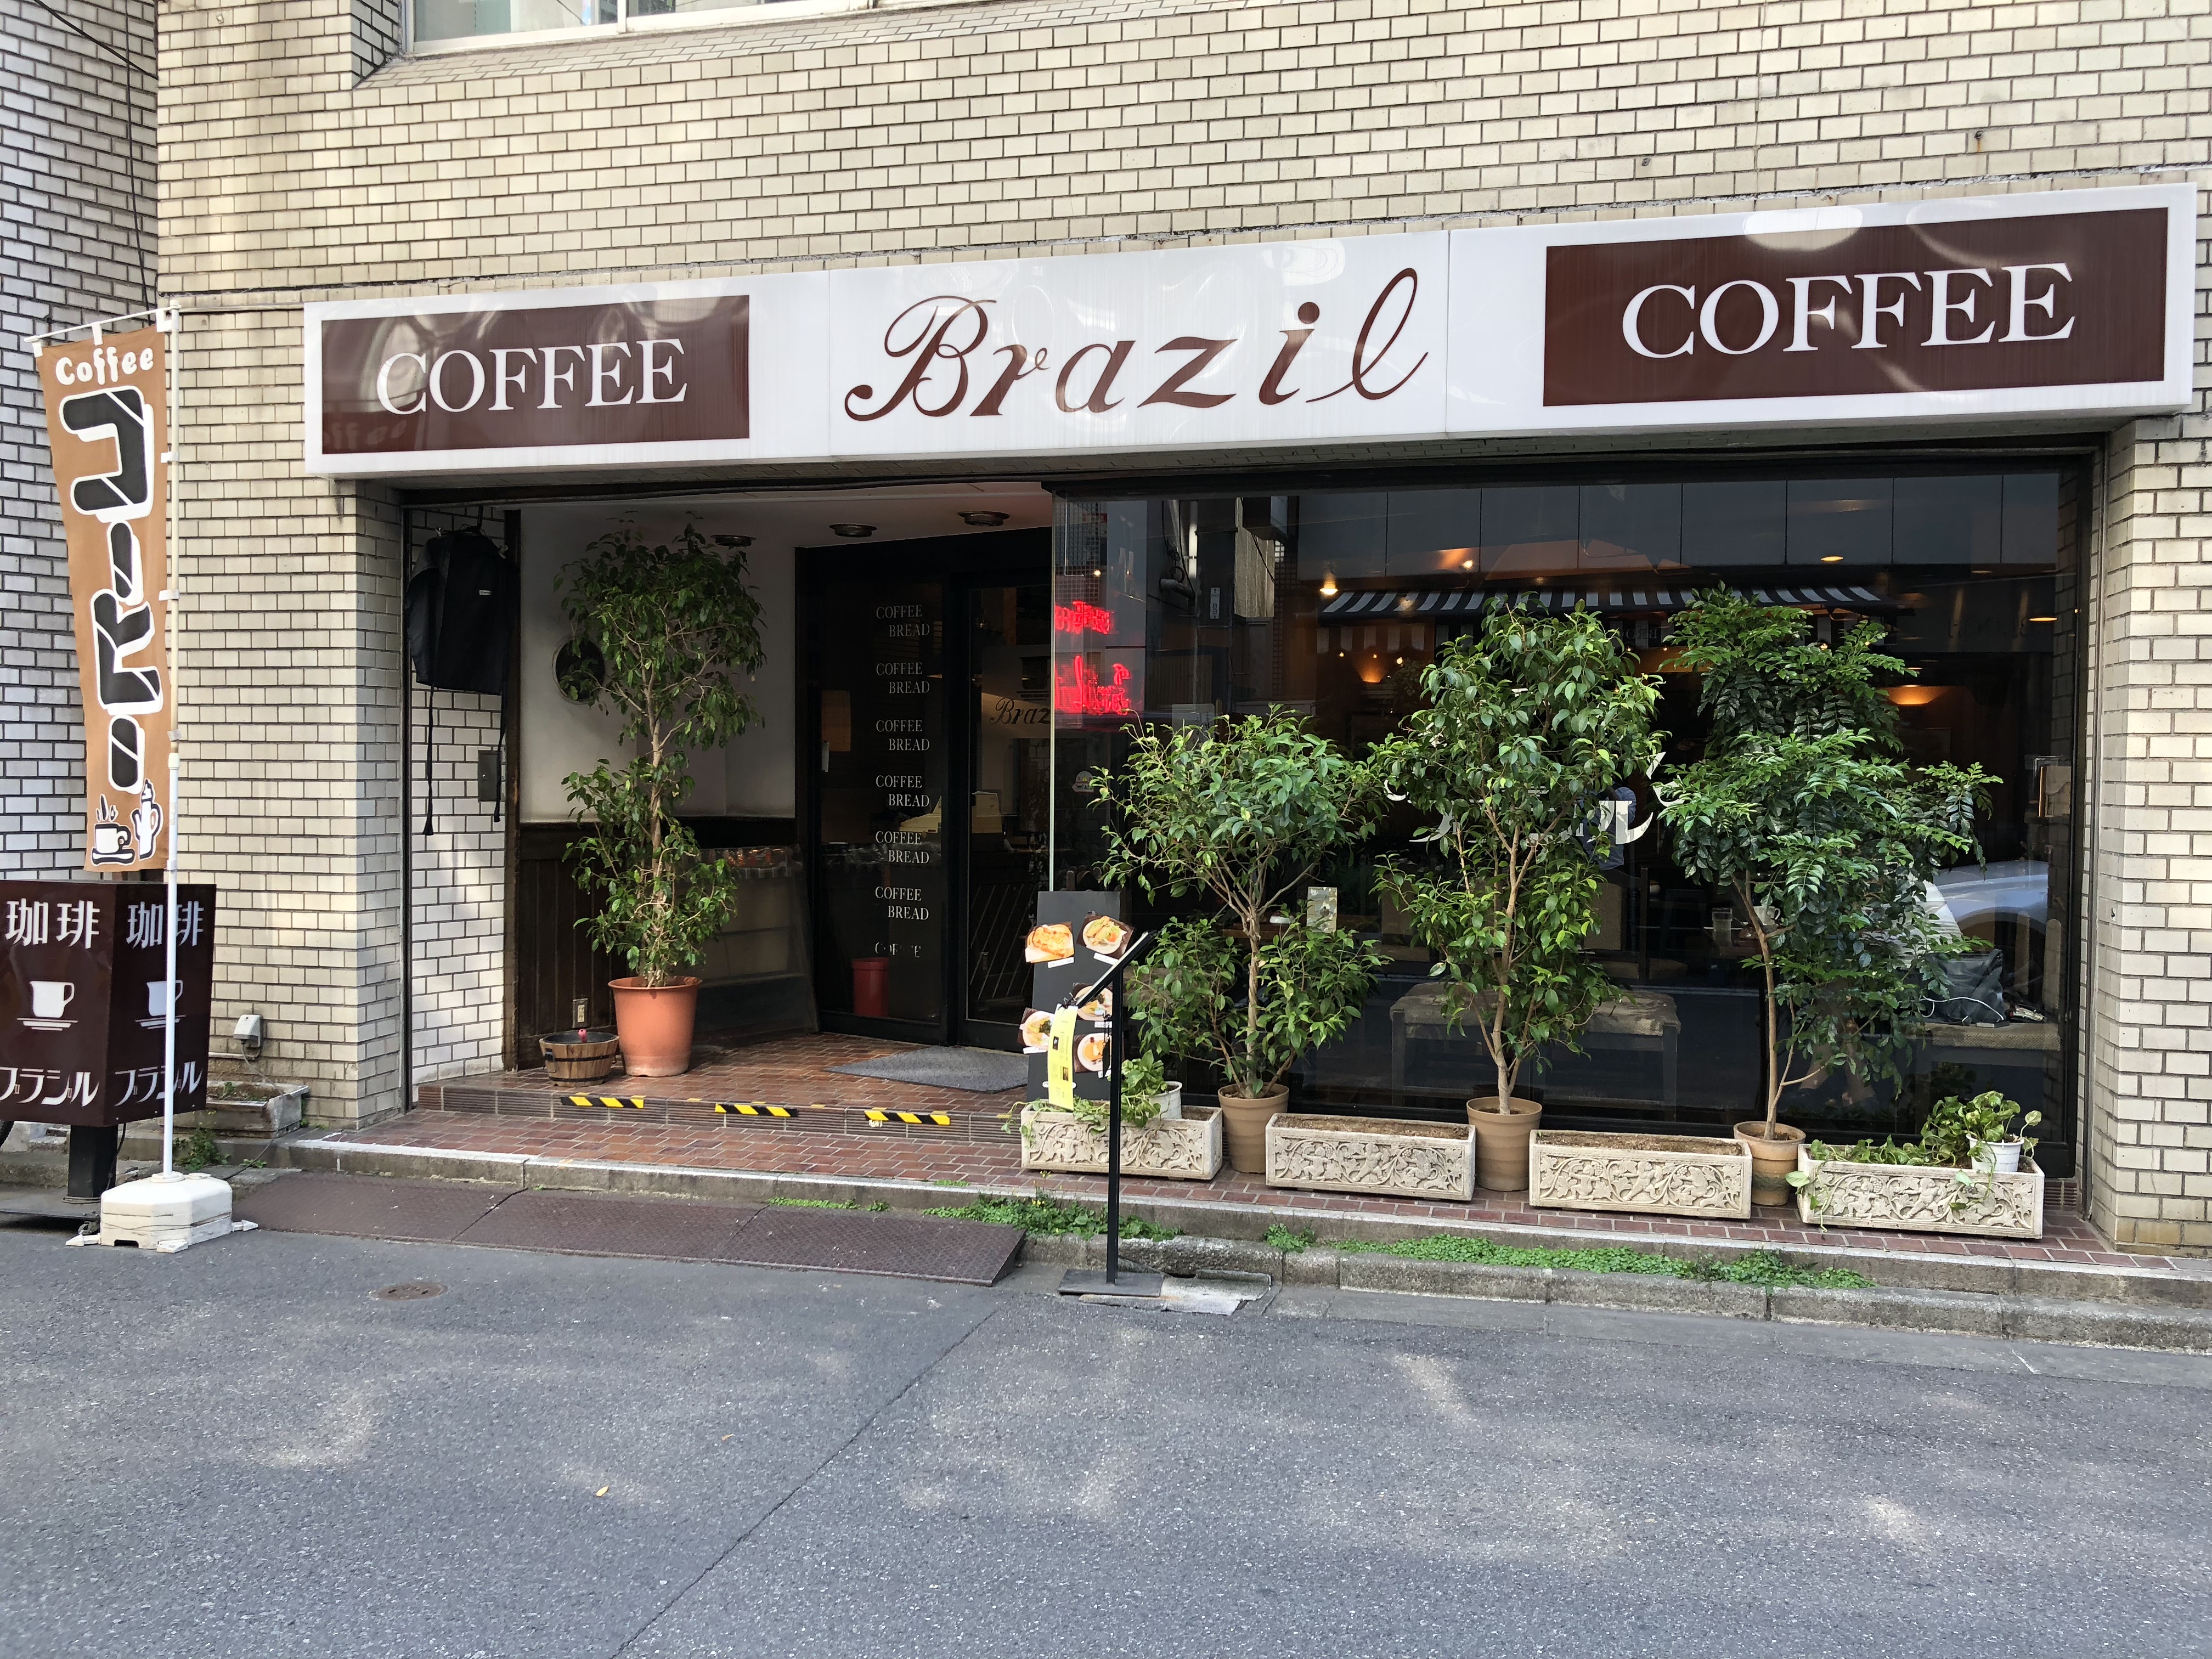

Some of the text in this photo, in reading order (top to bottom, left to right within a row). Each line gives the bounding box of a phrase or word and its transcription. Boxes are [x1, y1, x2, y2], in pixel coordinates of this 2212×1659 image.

[1622, 263, 2076, 359] COFFEE
[844, 268, 1428, 421] Brazil
[55, 346, 154, 385] Coffee
[376, 338, 687, 415] COFFEE
[59, 385, 163, 794] コーヒー
[876, 605, 923, 619] COFFEE
[889, 623, 930, 637] BREAD
[876, 662, 923, 675] COFFEE
[889, 681, 930, 693] BREAD
[876, 720, 923, 732] COFFEE
[889, 738, 930, 751] BREAD
[876, 775, 922, 788] COFFEE
[888, 793, 930, 807] BREAD
[875, 831, 922, 844] COFFEE
[888, 850, 929, 864] BREAD
[875, 886, 922, 901] COFFEE
[888, 905, 929, 920] BREAD
[5, 898, 100, 949] 珈琲
[126, 900, 205, 949] 珈琲
